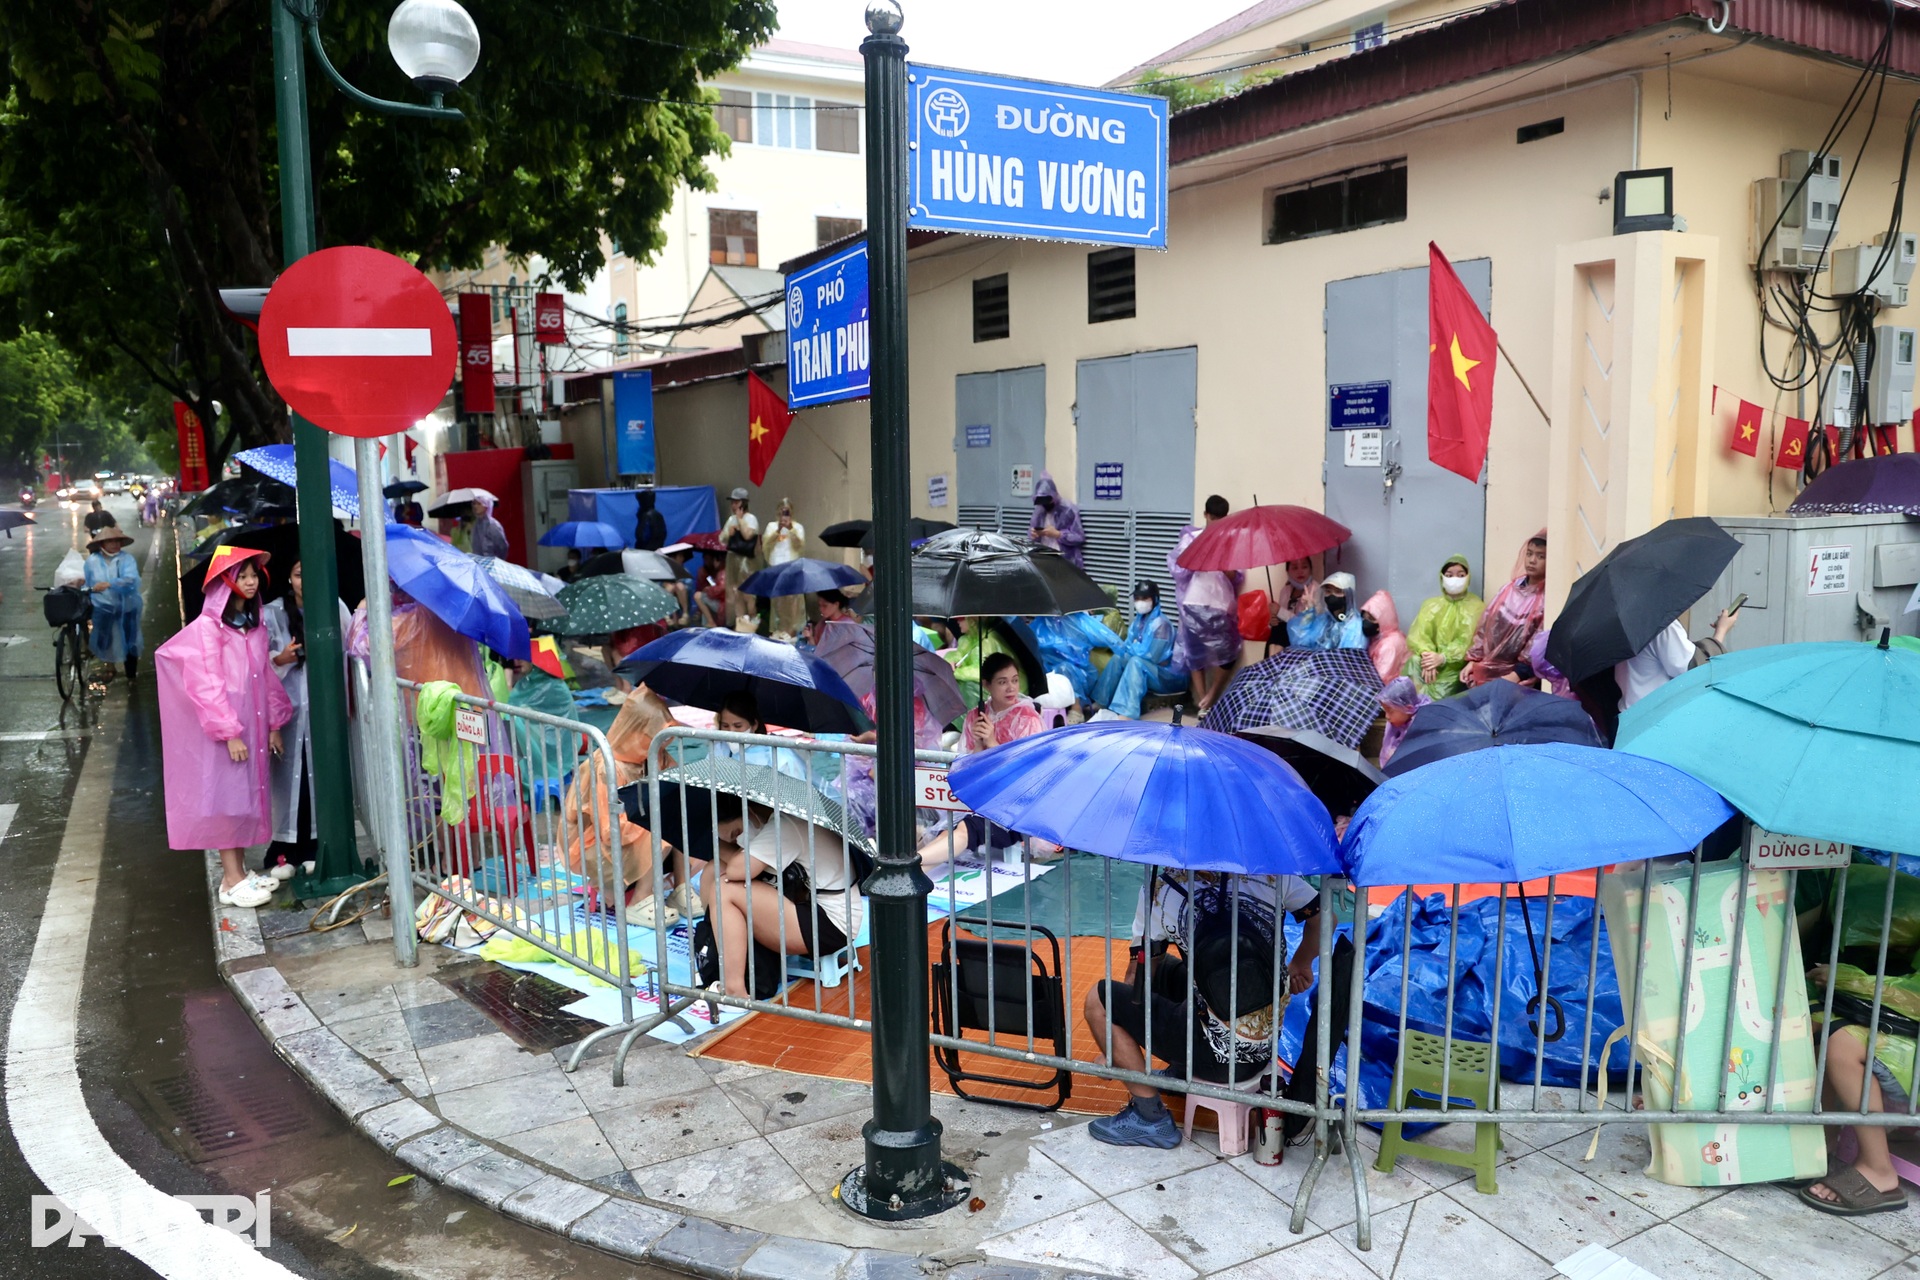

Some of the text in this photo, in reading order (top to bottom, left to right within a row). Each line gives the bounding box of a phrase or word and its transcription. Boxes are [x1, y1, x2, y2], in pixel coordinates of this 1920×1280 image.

[995, 103, 1126, 144] ĐƯỜNG
[931, 140, 1146, 219] HÙNG VƯƠNG
[817, 264, 845, 309] PHỐ
[539, 313, 561, 328] 5G
[793, 308, 869, 385] TRẦN PHÚ
[467, 350, 490, 365] 5G
[929, 774, 948, 782] POL
[925, 787, 959, 803] STO
[1759, 840, 1844, 858] DỪNG LẠI
